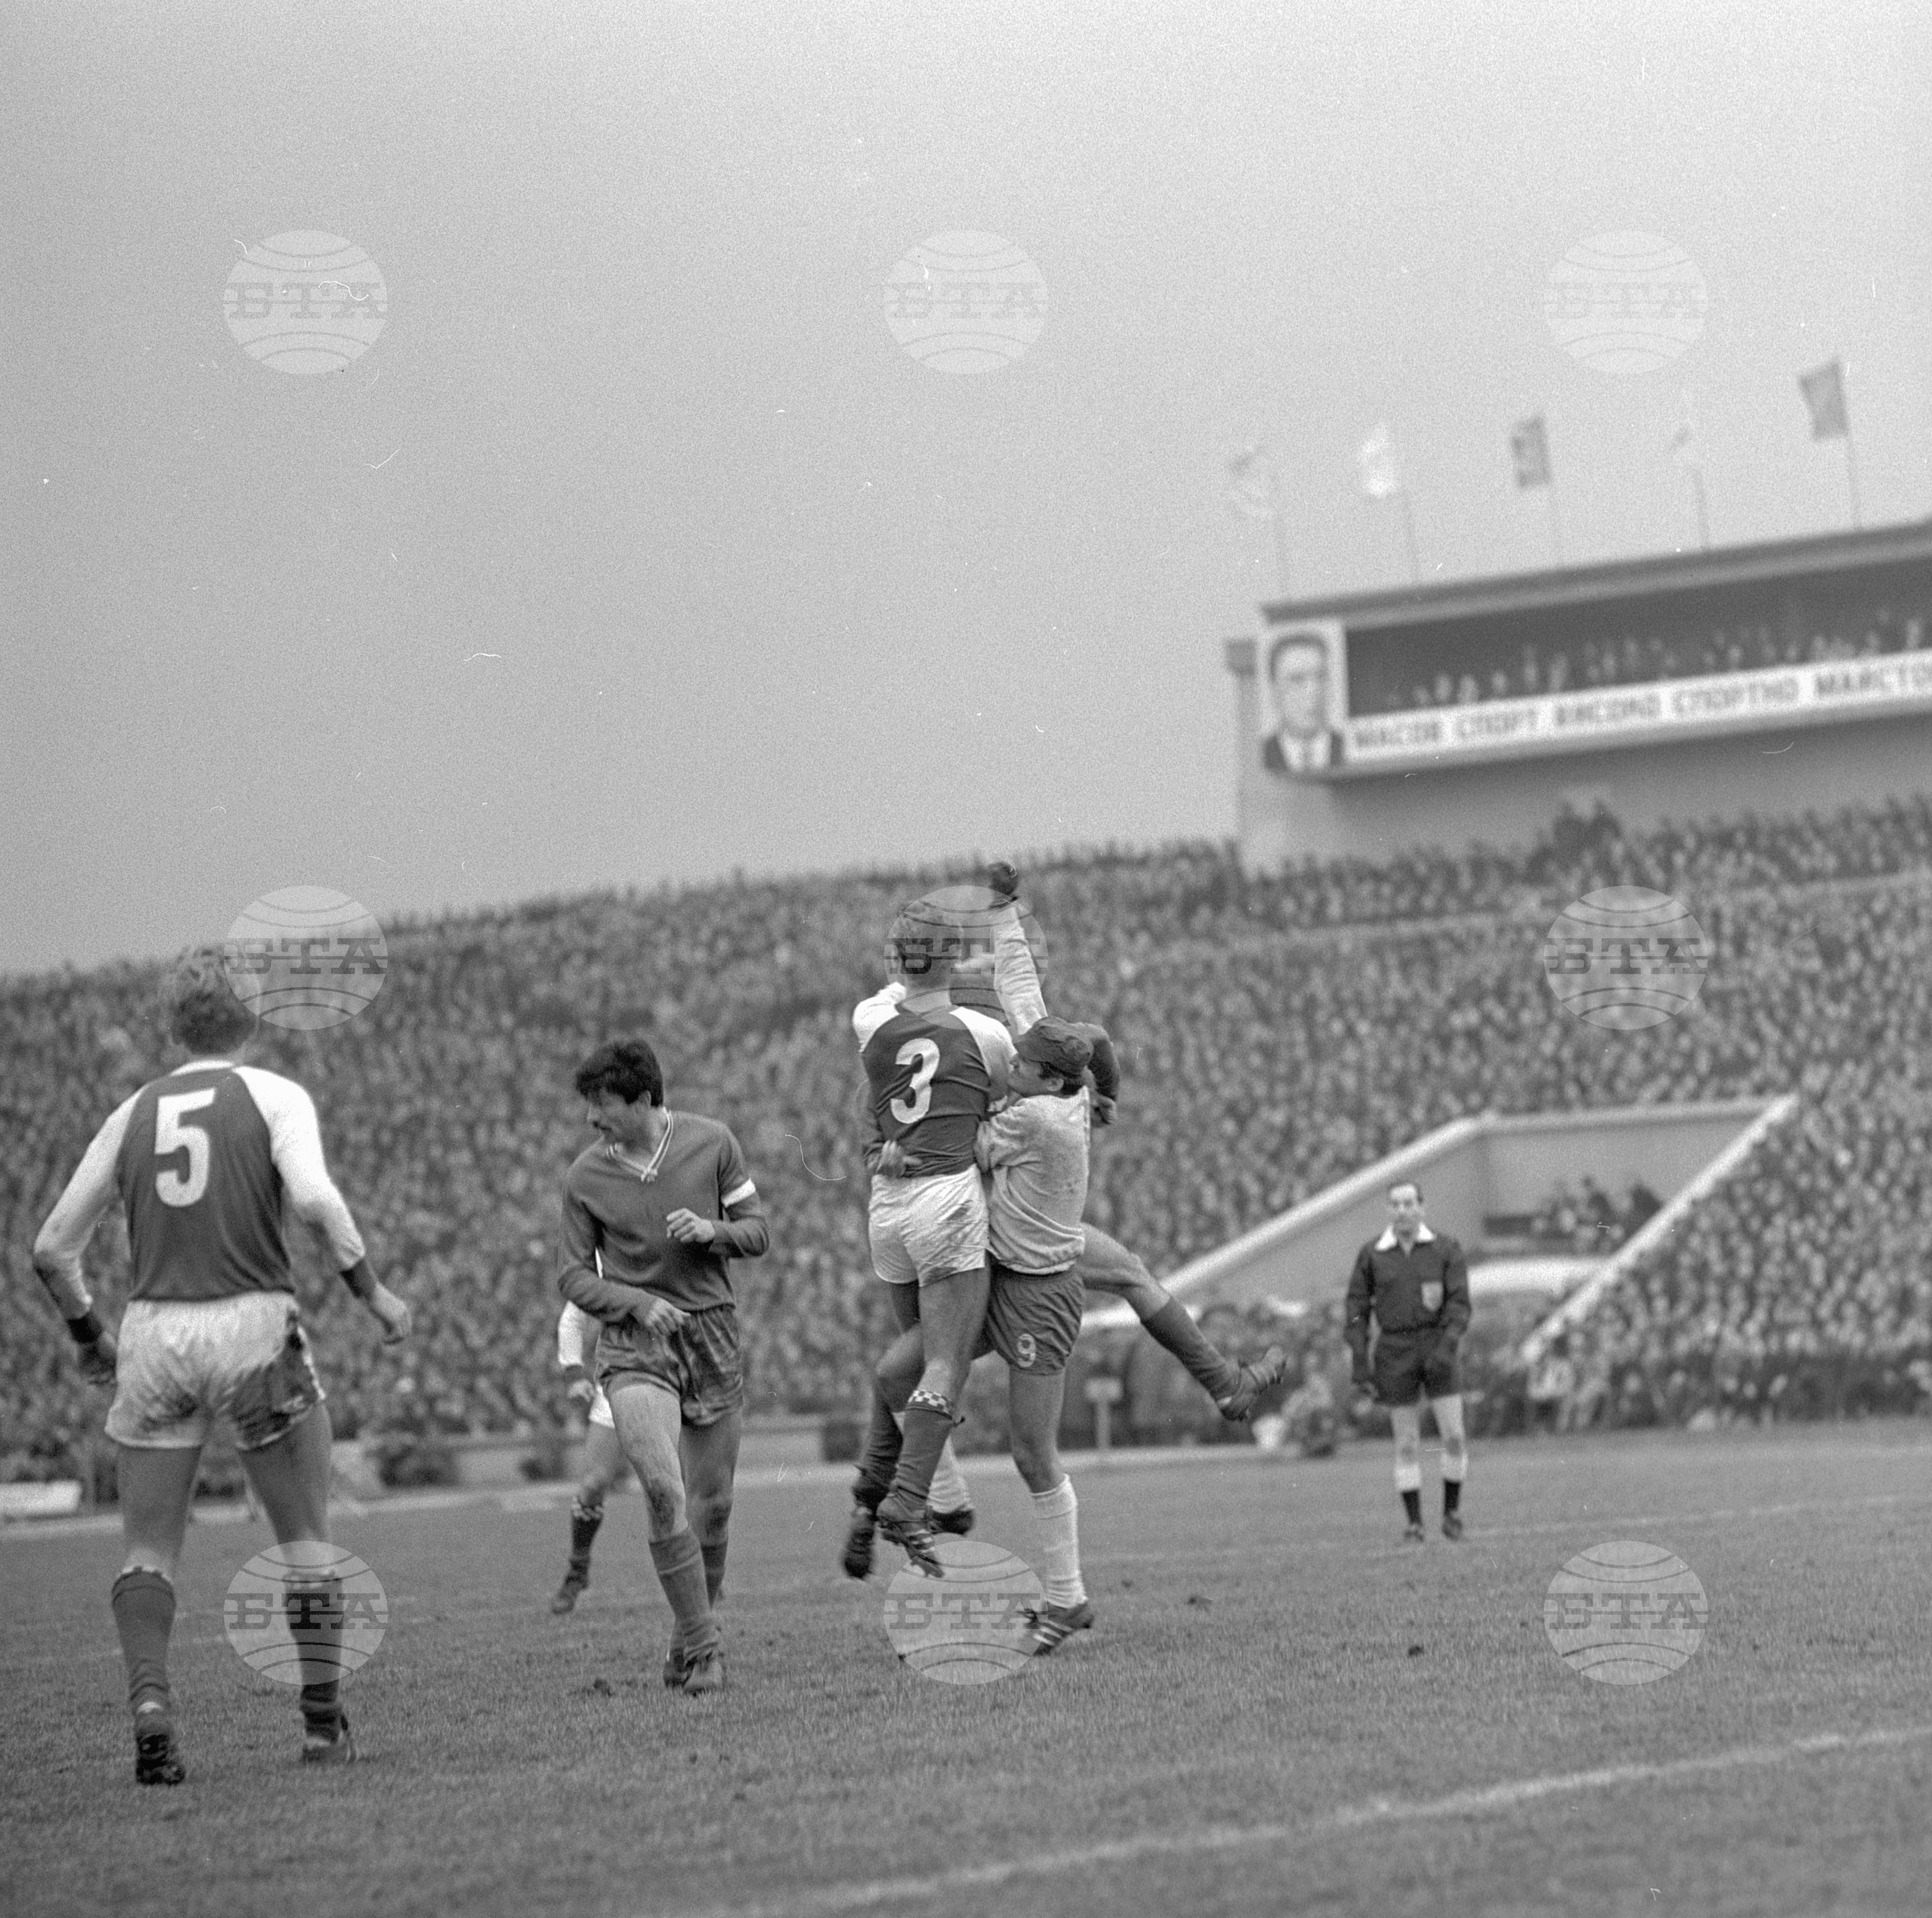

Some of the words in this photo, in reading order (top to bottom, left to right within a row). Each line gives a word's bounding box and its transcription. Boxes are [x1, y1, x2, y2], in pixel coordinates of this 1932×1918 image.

[890, 1038, 940, 1124] 3
[155, 1088, 216, 1207] 5
[1017, 1333, 1036, 1368] 9
